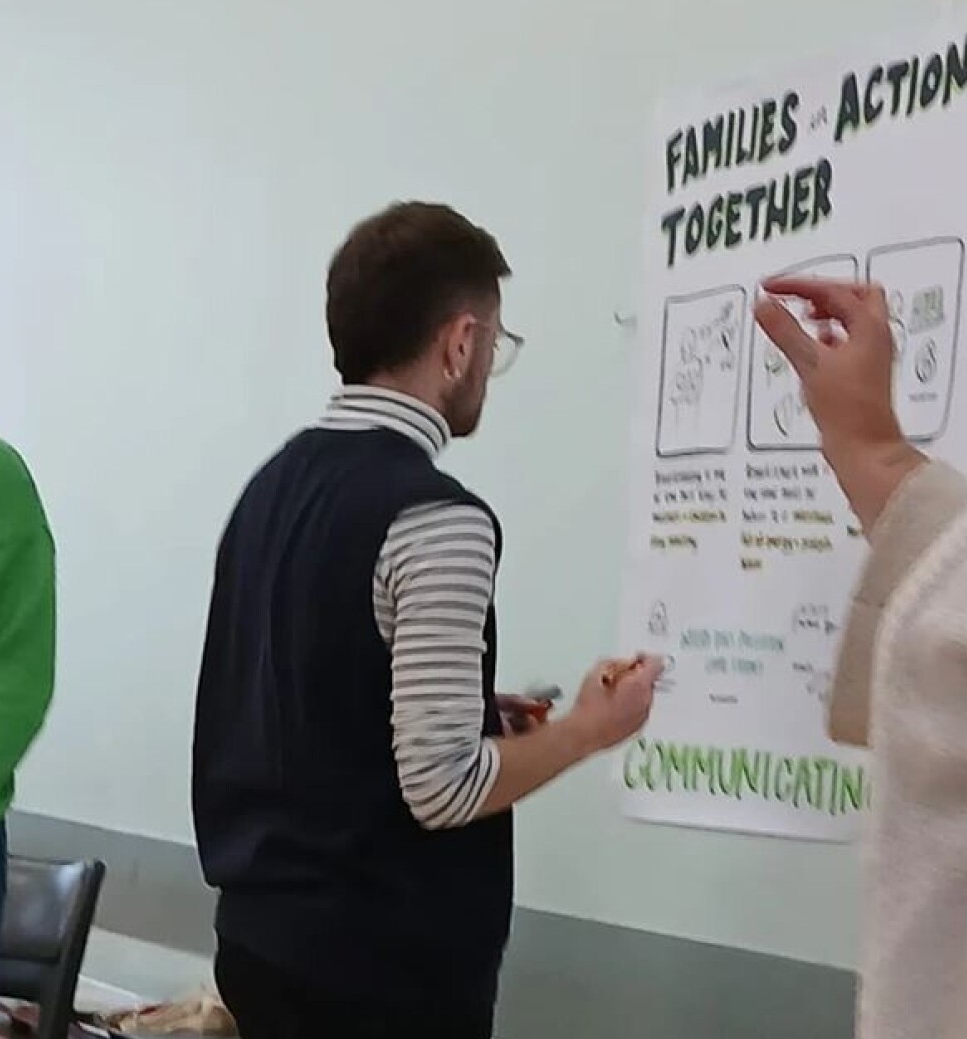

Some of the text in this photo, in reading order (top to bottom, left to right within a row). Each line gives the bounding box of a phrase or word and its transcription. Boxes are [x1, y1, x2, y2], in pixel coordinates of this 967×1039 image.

[665, 92, 799, 192] FAMILIES
[834, 33, 967, 141] ACTION
[661, 157, 833, 267] TOGETHER
[623, 738, 872, 816] COMMUNICATIN
